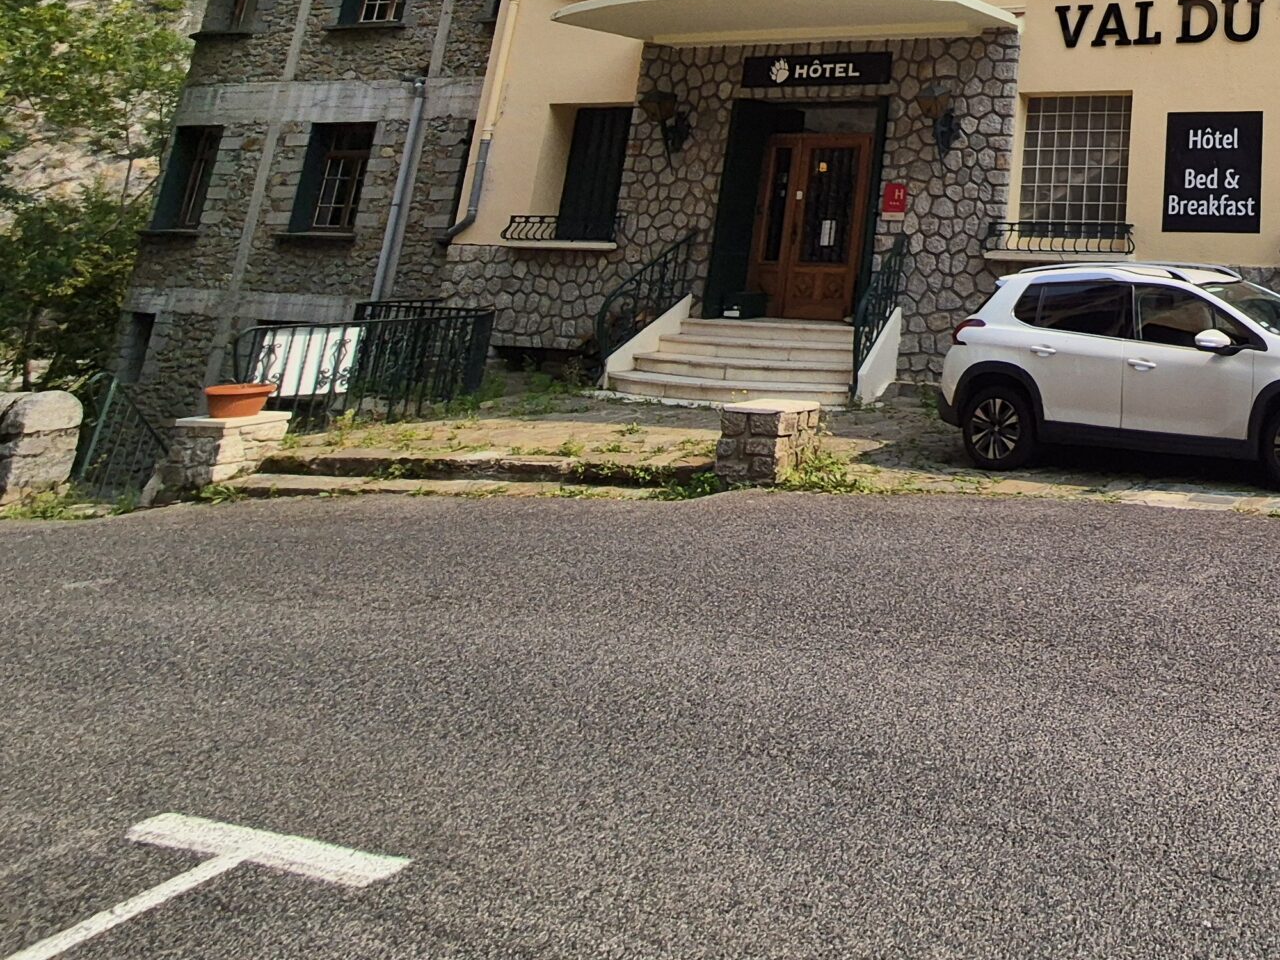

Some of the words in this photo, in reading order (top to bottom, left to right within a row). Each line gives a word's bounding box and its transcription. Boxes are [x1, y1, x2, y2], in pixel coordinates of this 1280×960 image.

[1055, 0, 1162, 49] VAL
[794, 59, 860, 79] HÔTEL
[1188, 127, 1239, 149] Hôtel
[1184, 167, 1218, 189] Bed
[1224, 168, 1240, 189] &
[894, 188, 905, 200] H
[1167, 194, 1256, 216] Breakfast
